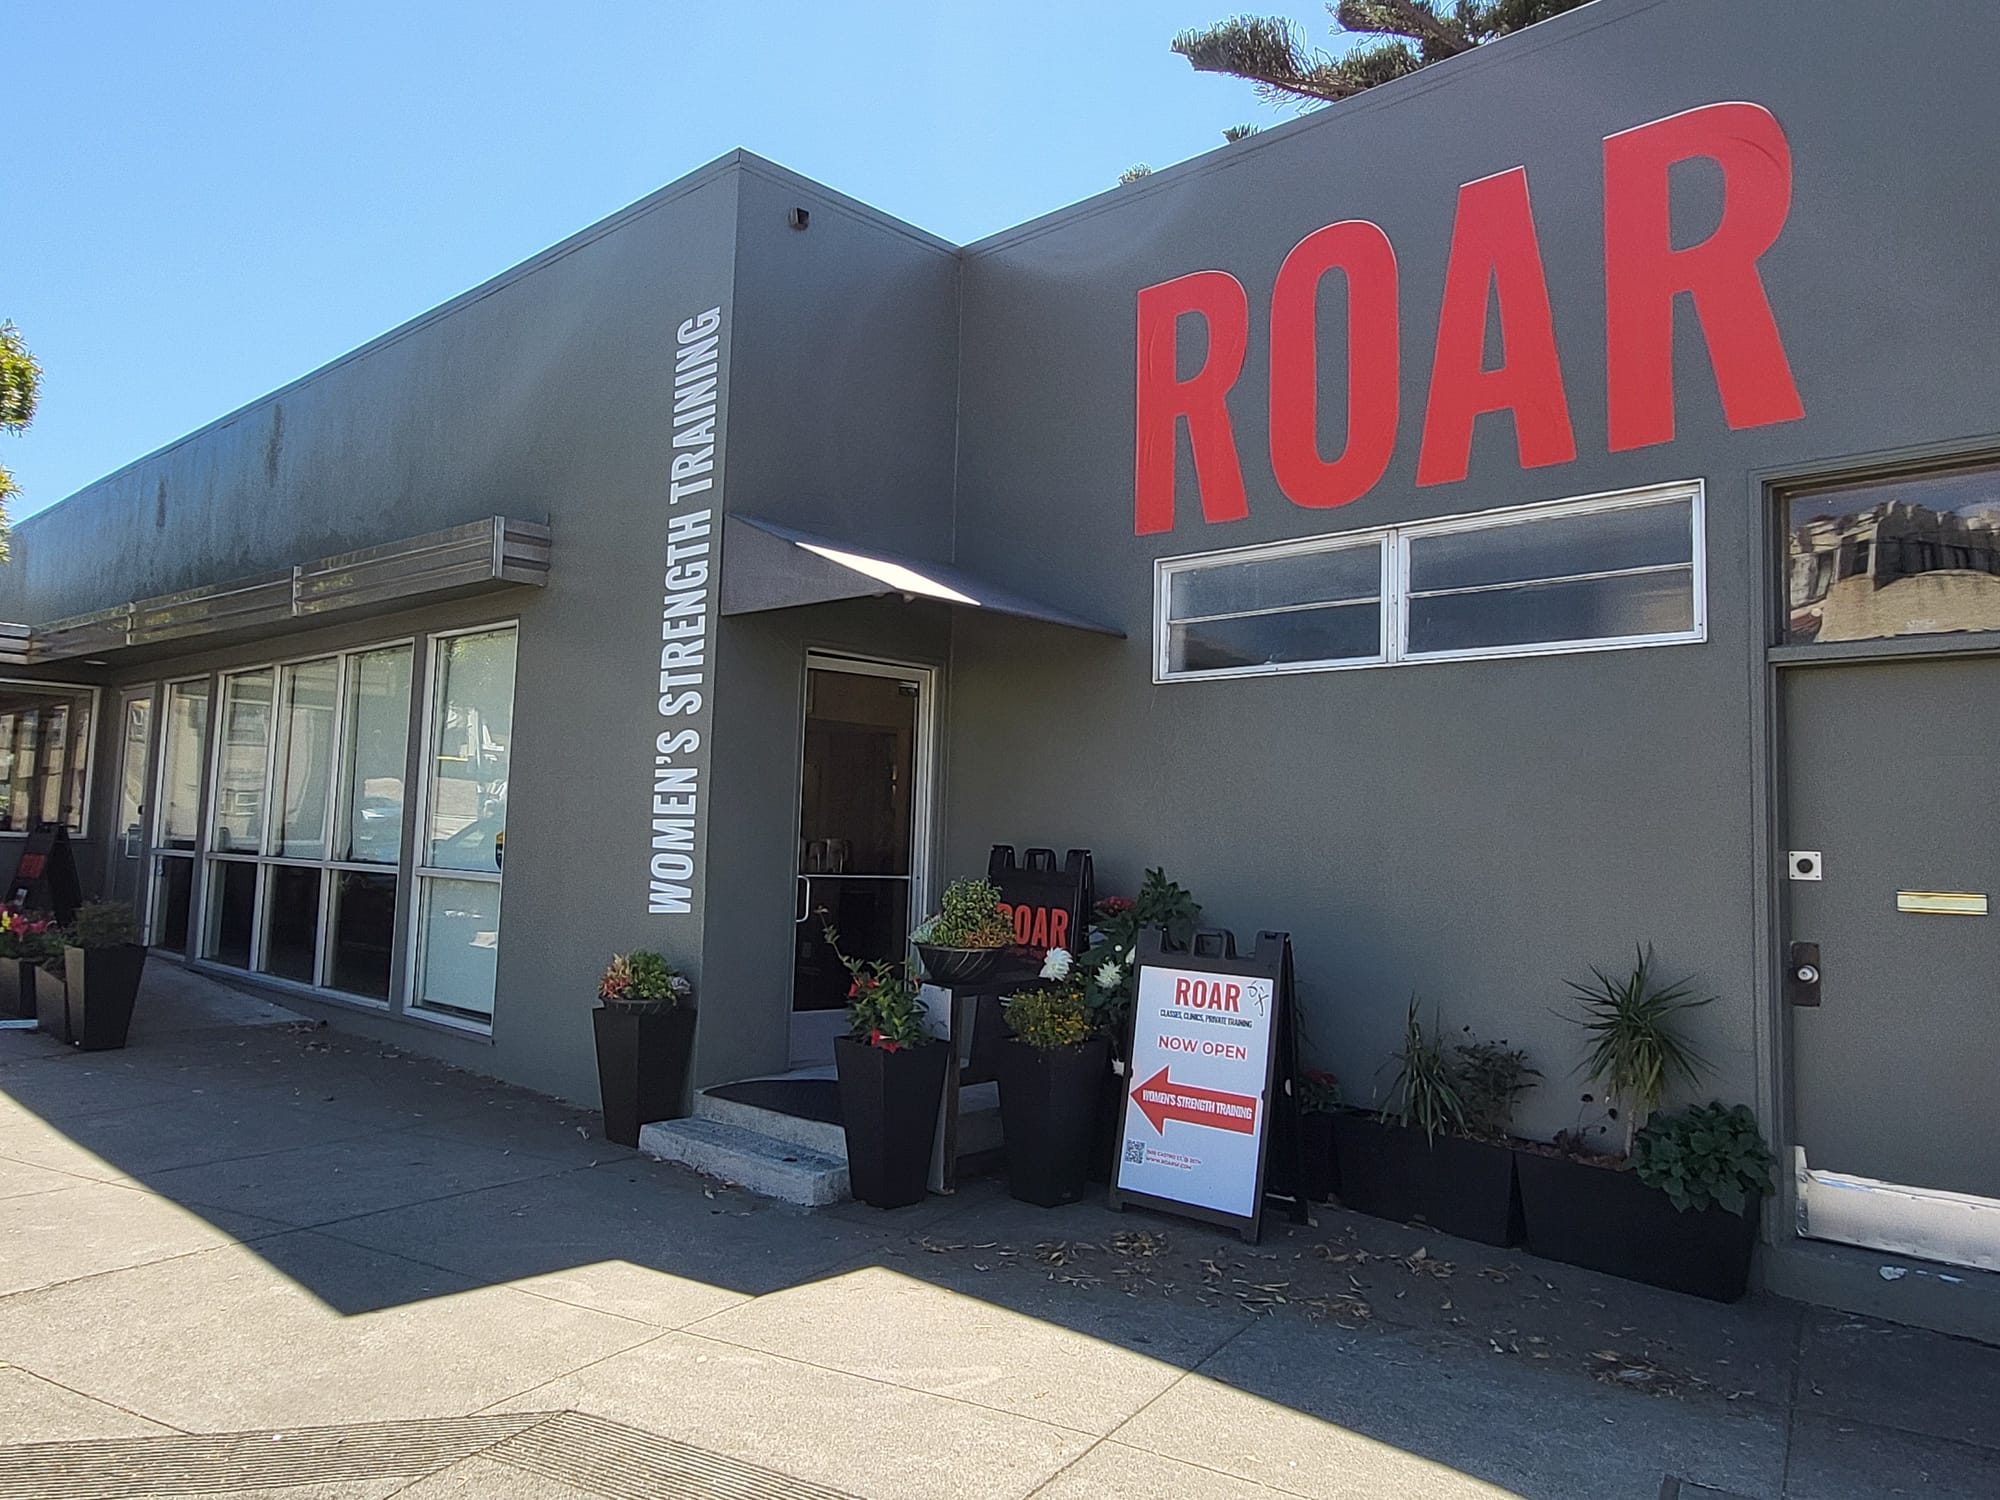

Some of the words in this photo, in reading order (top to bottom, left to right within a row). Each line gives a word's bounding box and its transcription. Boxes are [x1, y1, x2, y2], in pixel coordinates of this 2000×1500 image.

[1134, 100, 1806, 536] ROAR
[670, 305, 721, 505] TRAINING
[658, 508, 712, 716] STRENGTH
[648, 729, 699, 915] WOMEN'S
[1158, 1035, 1198, 1053] NOW
[1202, 1042, 1247, 1060] OPEN
[1175, 978, 1240, 1012] ROAR
[1205, 1015, 1226, 1024] PRIVATE
[1228, 1018, 1252, 1028] TRAINING
[1143, 1090, 1176, 1105] WOMEN'S
[1176, 1095, 1215, 1113] STRENGTH
[1216, 1102, 1253, 1119] TRAINING
